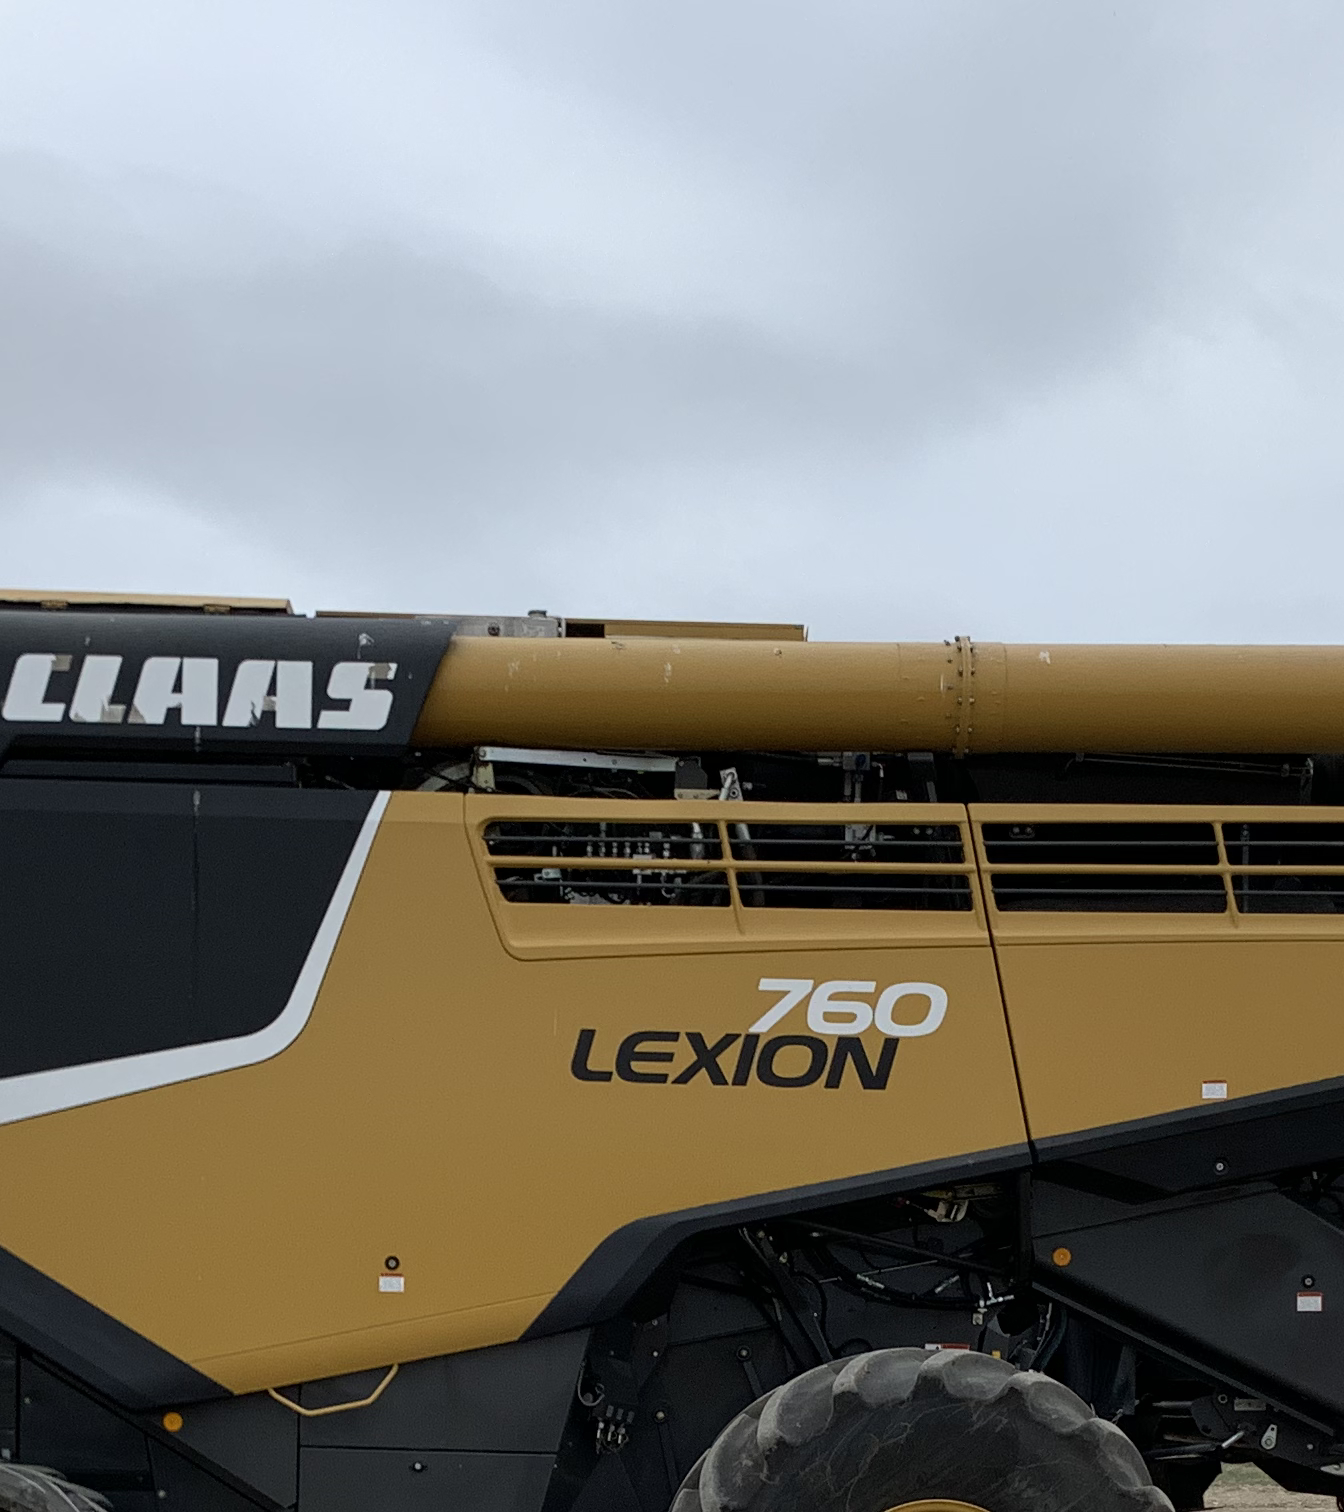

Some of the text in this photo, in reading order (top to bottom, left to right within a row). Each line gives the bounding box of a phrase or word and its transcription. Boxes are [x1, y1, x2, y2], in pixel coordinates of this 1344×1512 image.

[1, 653, 397, 730] CLAAS
[748, 977, 949, 1037] 760
[570, 1028, 900, 1091] LEXION
